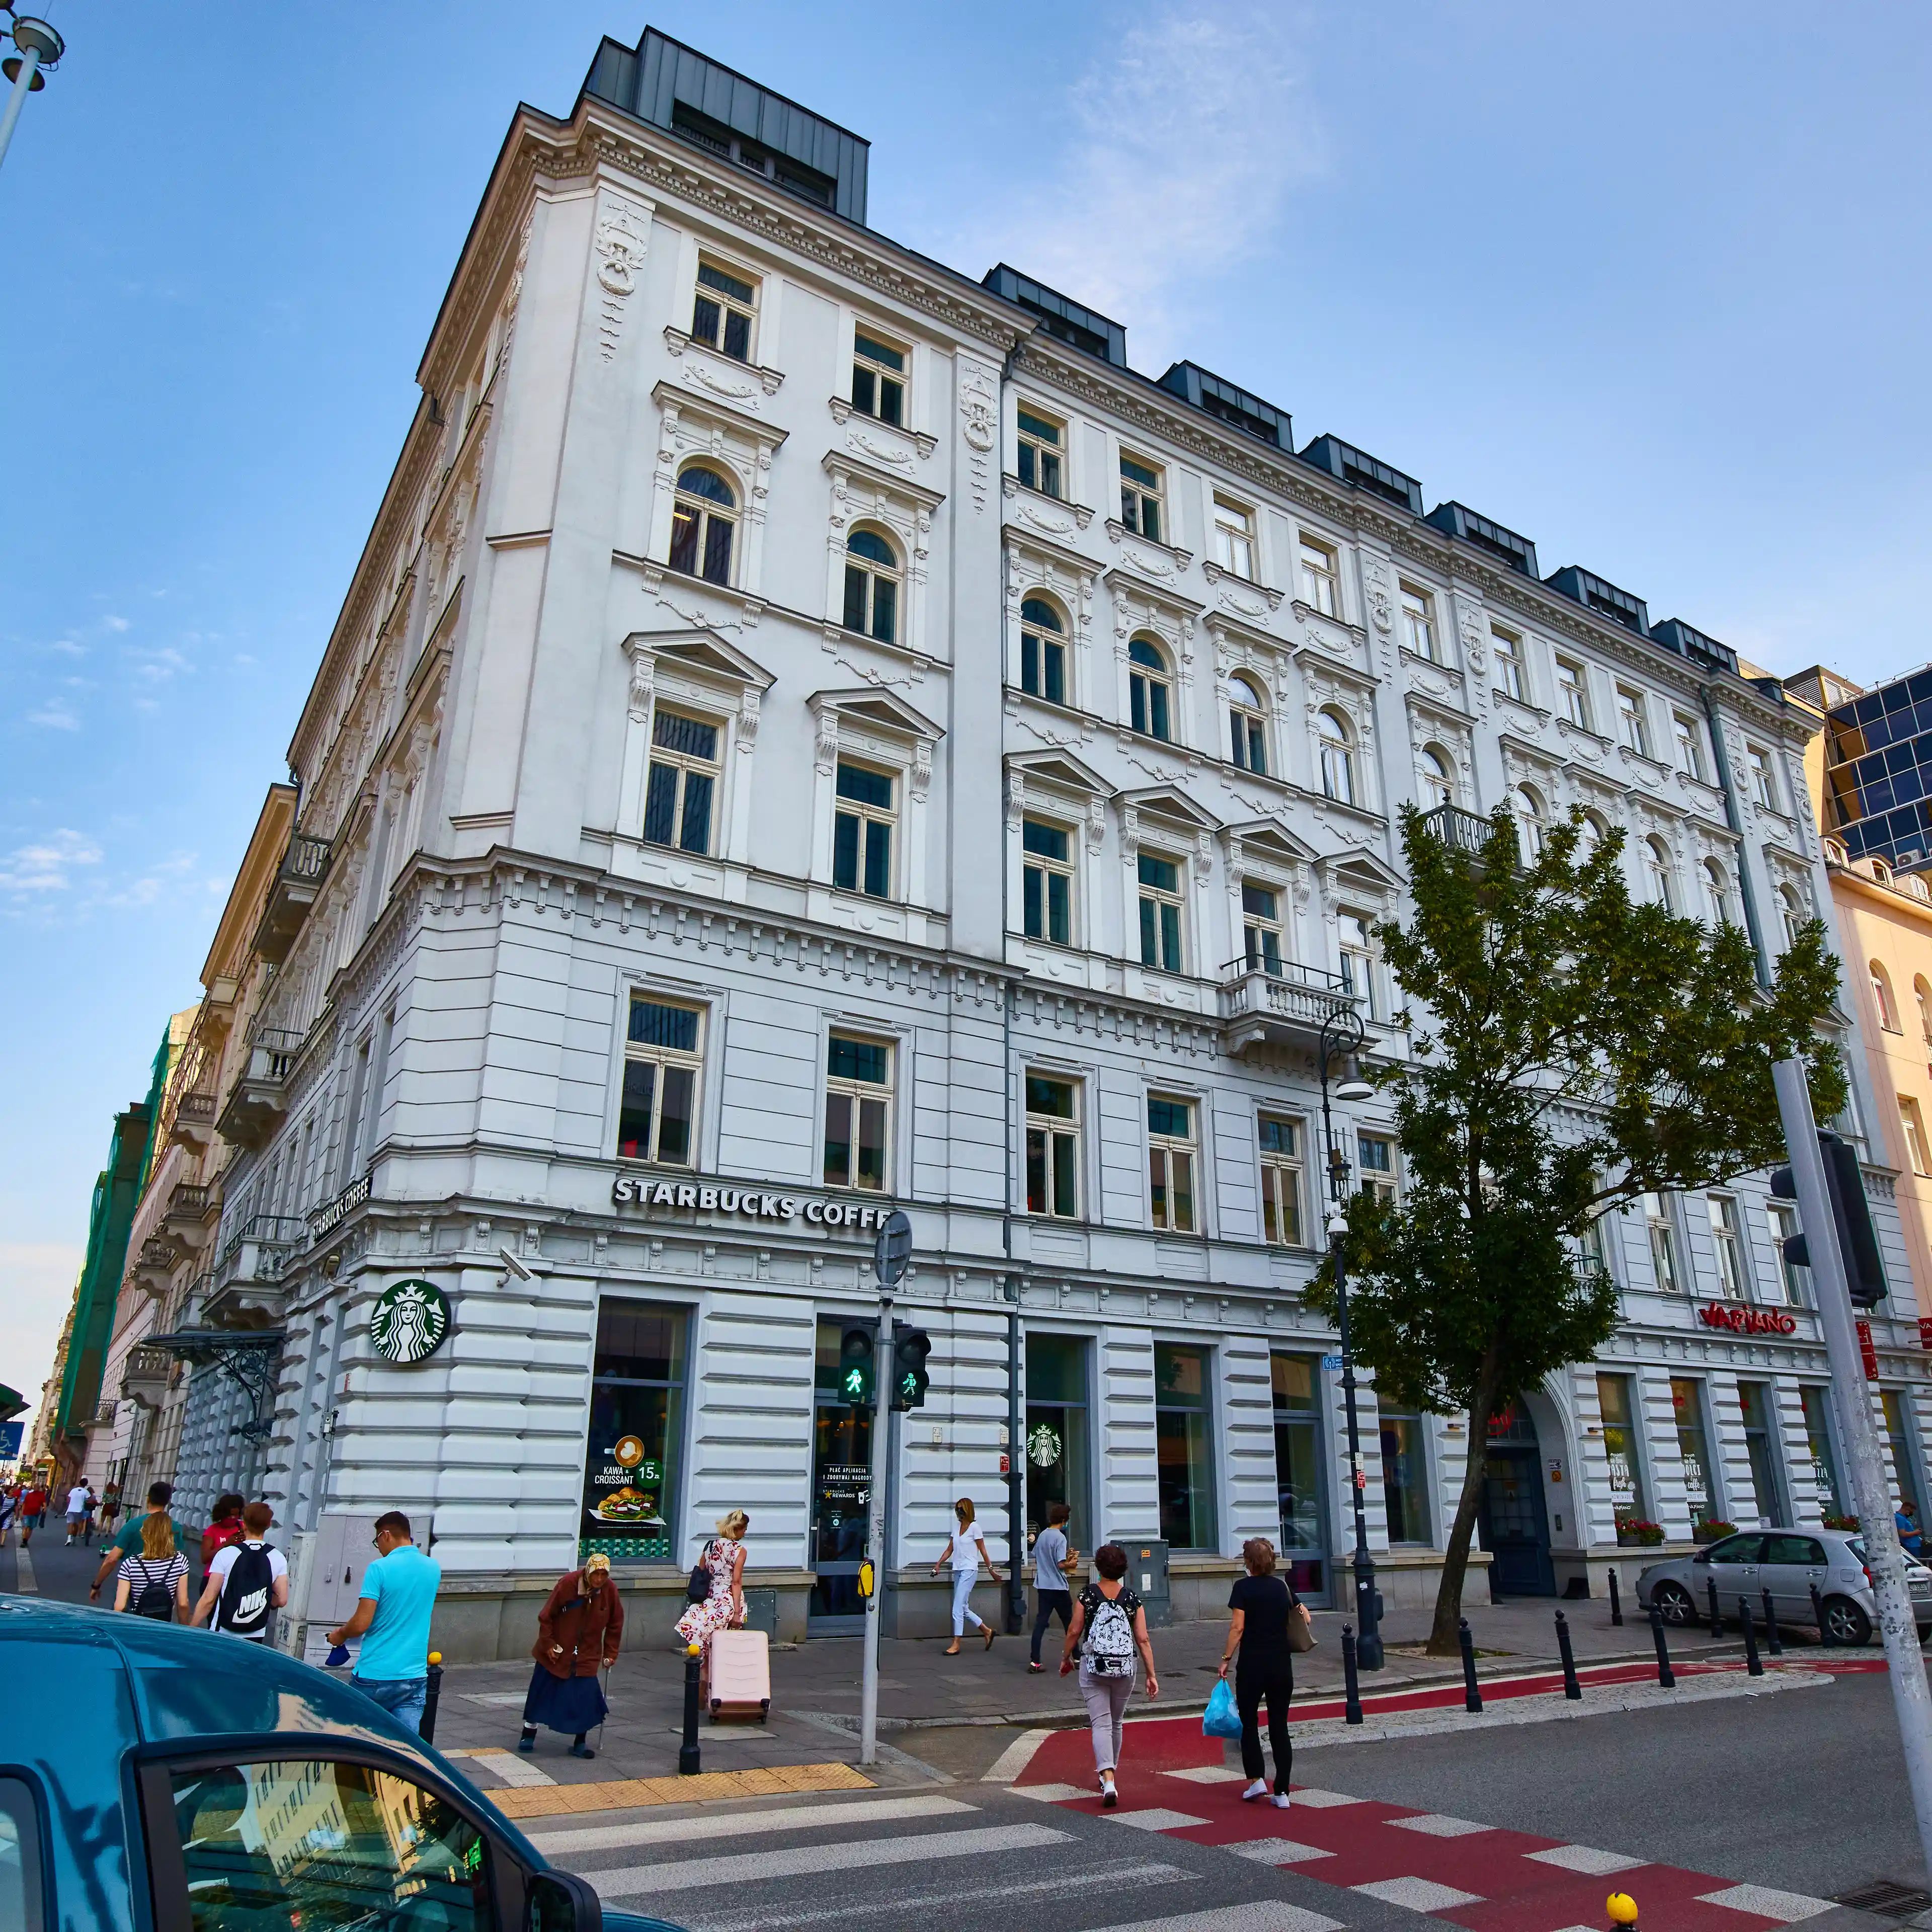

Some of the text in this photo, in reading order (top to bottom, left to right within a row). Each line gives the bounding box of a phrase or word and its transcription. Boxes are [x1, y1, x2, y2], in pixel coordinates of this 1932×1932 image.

[313, 1177, 369, 1239] STARBUCKS COFFEE
[614, 1178, 891, 1230] STARBUCKS COFFE
[1698, 1302, 1797, 1334] VAPIANO
[603, 1466, 623, 1475] KAWA
[1611, 1464, 1630, 1477] ASTA
[1685, 1464, 1701, 1476] OLCI
[1817, 1467, 1828, 1478] ZZA
[595, 1475, 634, 1485] CROISSANT
